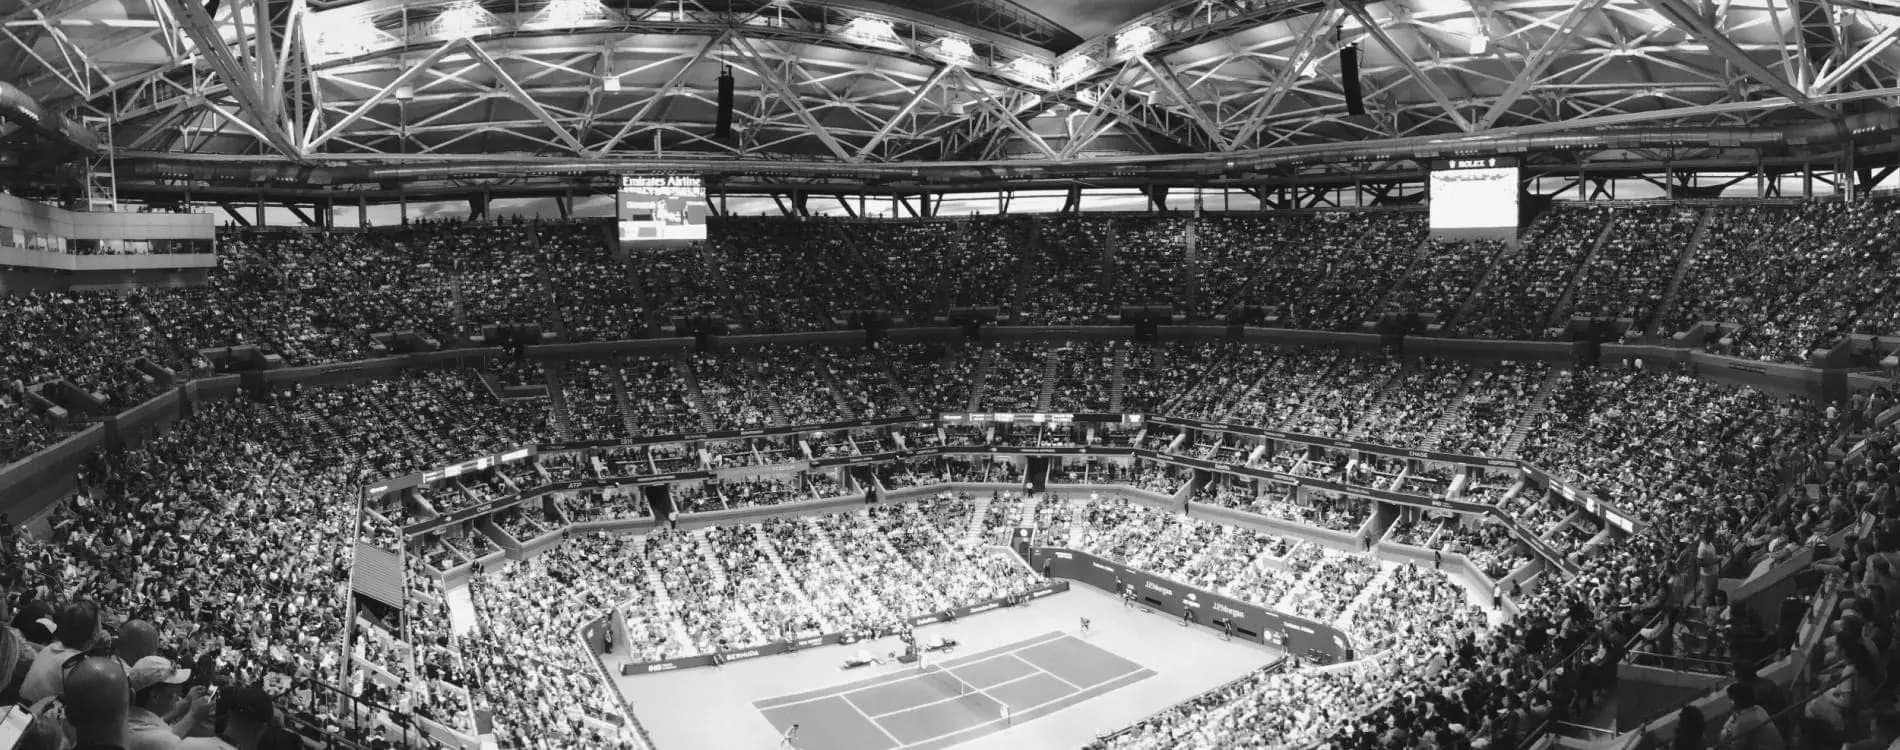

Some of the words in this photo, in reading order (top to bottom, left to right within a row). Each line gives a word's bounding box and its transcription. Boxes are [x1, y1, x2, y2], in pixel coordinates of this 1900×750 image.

[1458, 160, 1486, 168] ROLEX
[622, 176, 665, 187] Emirates
[667, 176, 701, 187] Airline
